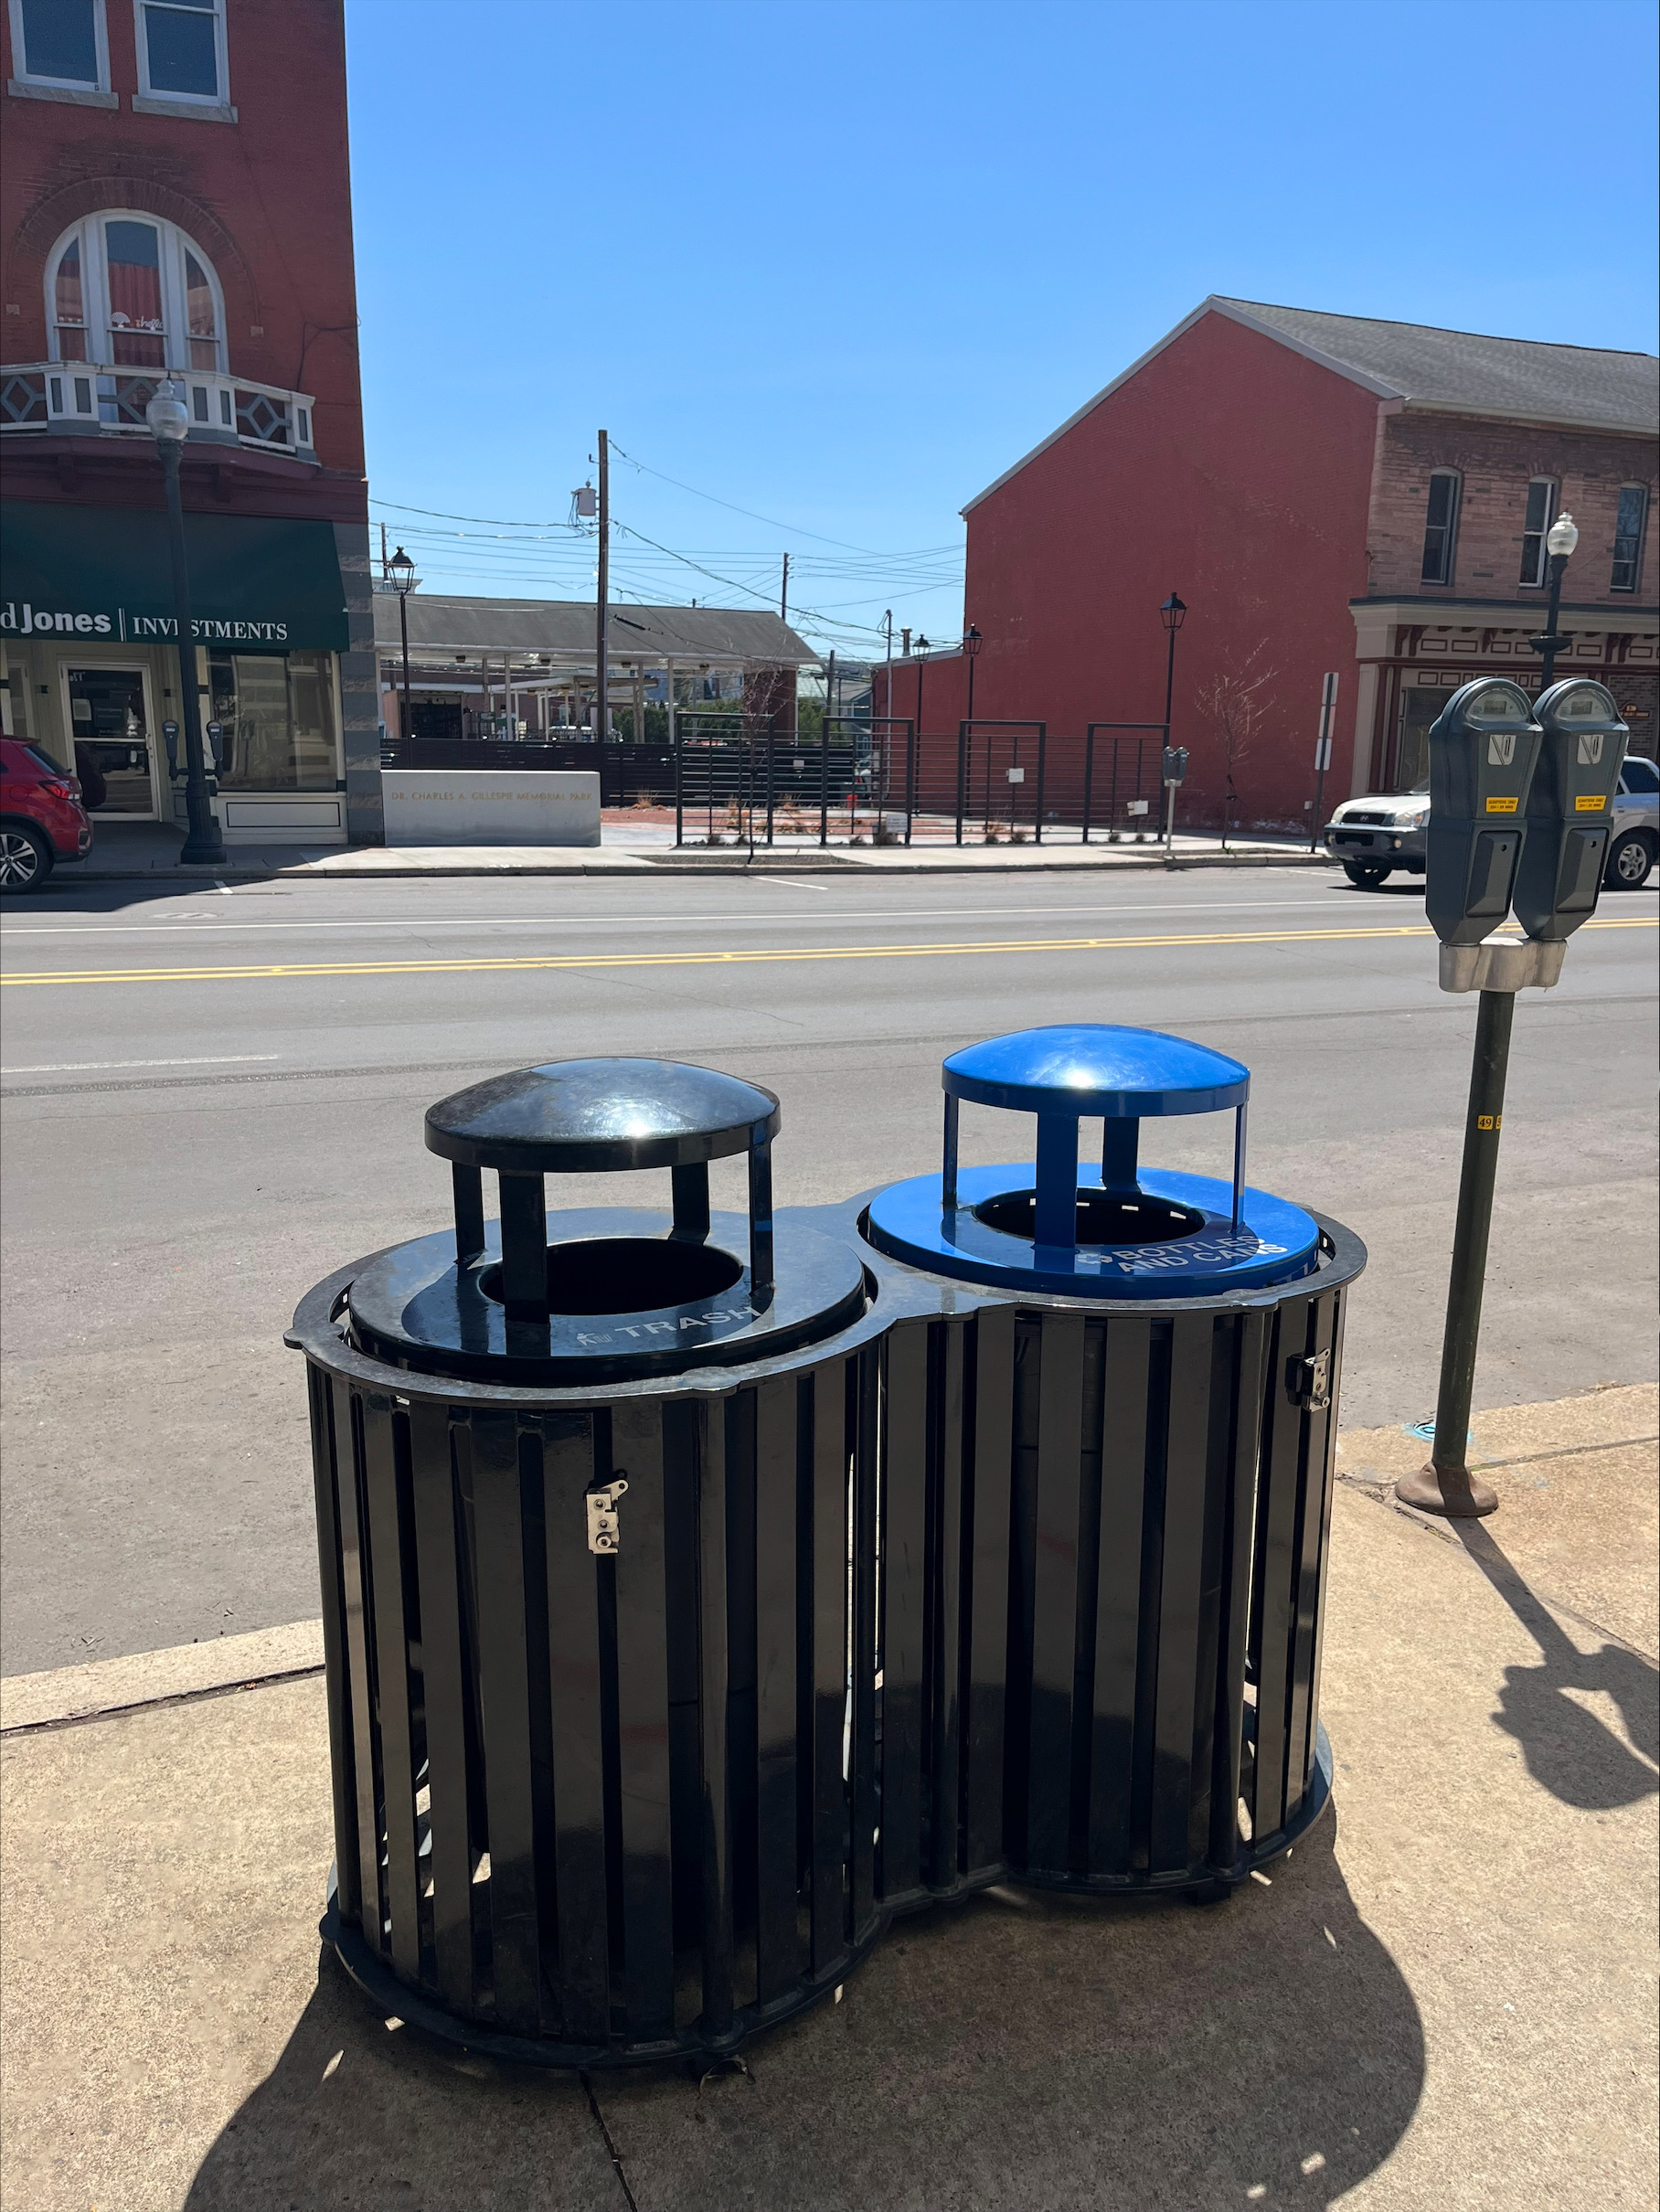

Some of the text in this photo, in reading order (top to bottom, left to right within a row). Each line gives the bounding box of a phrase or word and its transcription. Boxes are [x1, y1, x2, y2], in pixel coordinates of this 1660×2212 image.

[411, 792, 454, 801] CHARLES
[472, 792, 513, 801] GILLESPIE
[516, 792, 566, 801] MEMORIAL
[569, 792, 592, 801] PARK
[1479, 1118, 1492, 1128] 49
[1112, 1235, 1265, 1260] BOTTLES
[1118, 1243, 1288, 1272] AND CANS
[614, 1306, 762, 1338] TRASH
